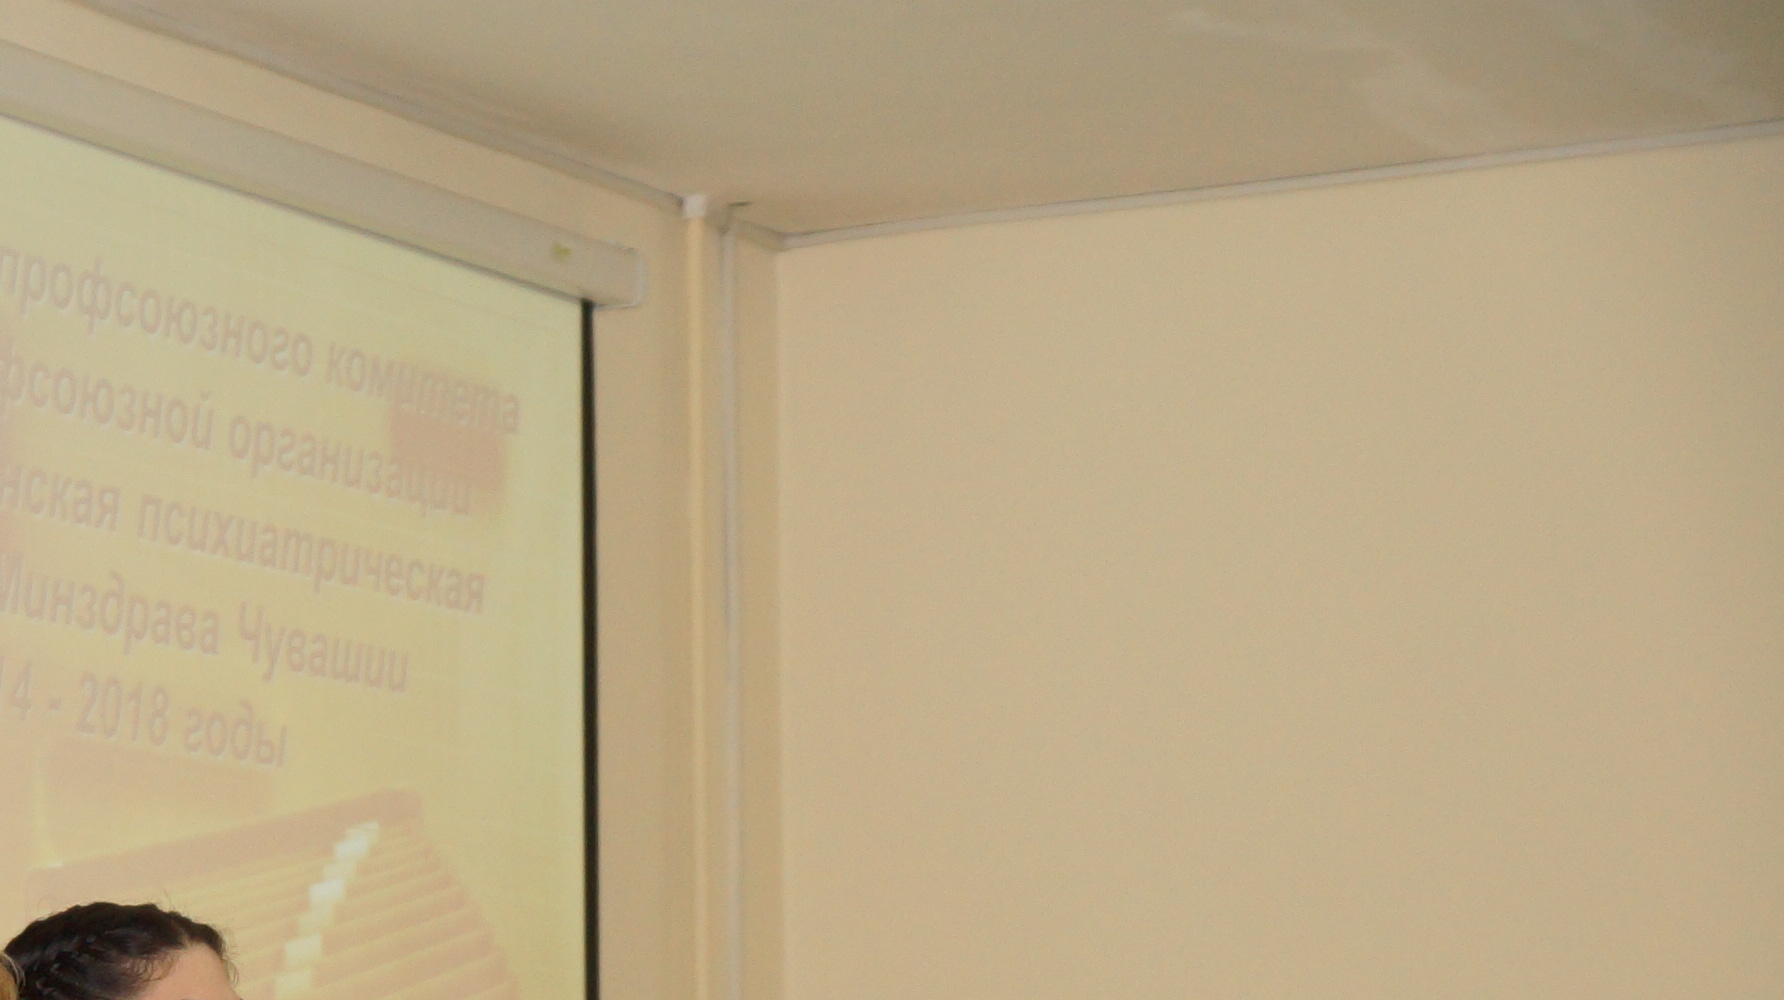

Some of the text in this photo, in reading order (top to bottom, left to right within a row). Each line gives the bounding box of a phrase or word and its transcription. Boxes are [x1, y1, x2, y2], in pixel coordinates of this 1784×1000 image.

[326, 341, 520, 435] комитета
[228, 413, 472, 517] организации
[136, 491, 486, 615] психиатрическая
[237, 601, 411, 694] Чувашии
[75, 670, 171, 748] 2018
[183, 699, 290, 768] годы
